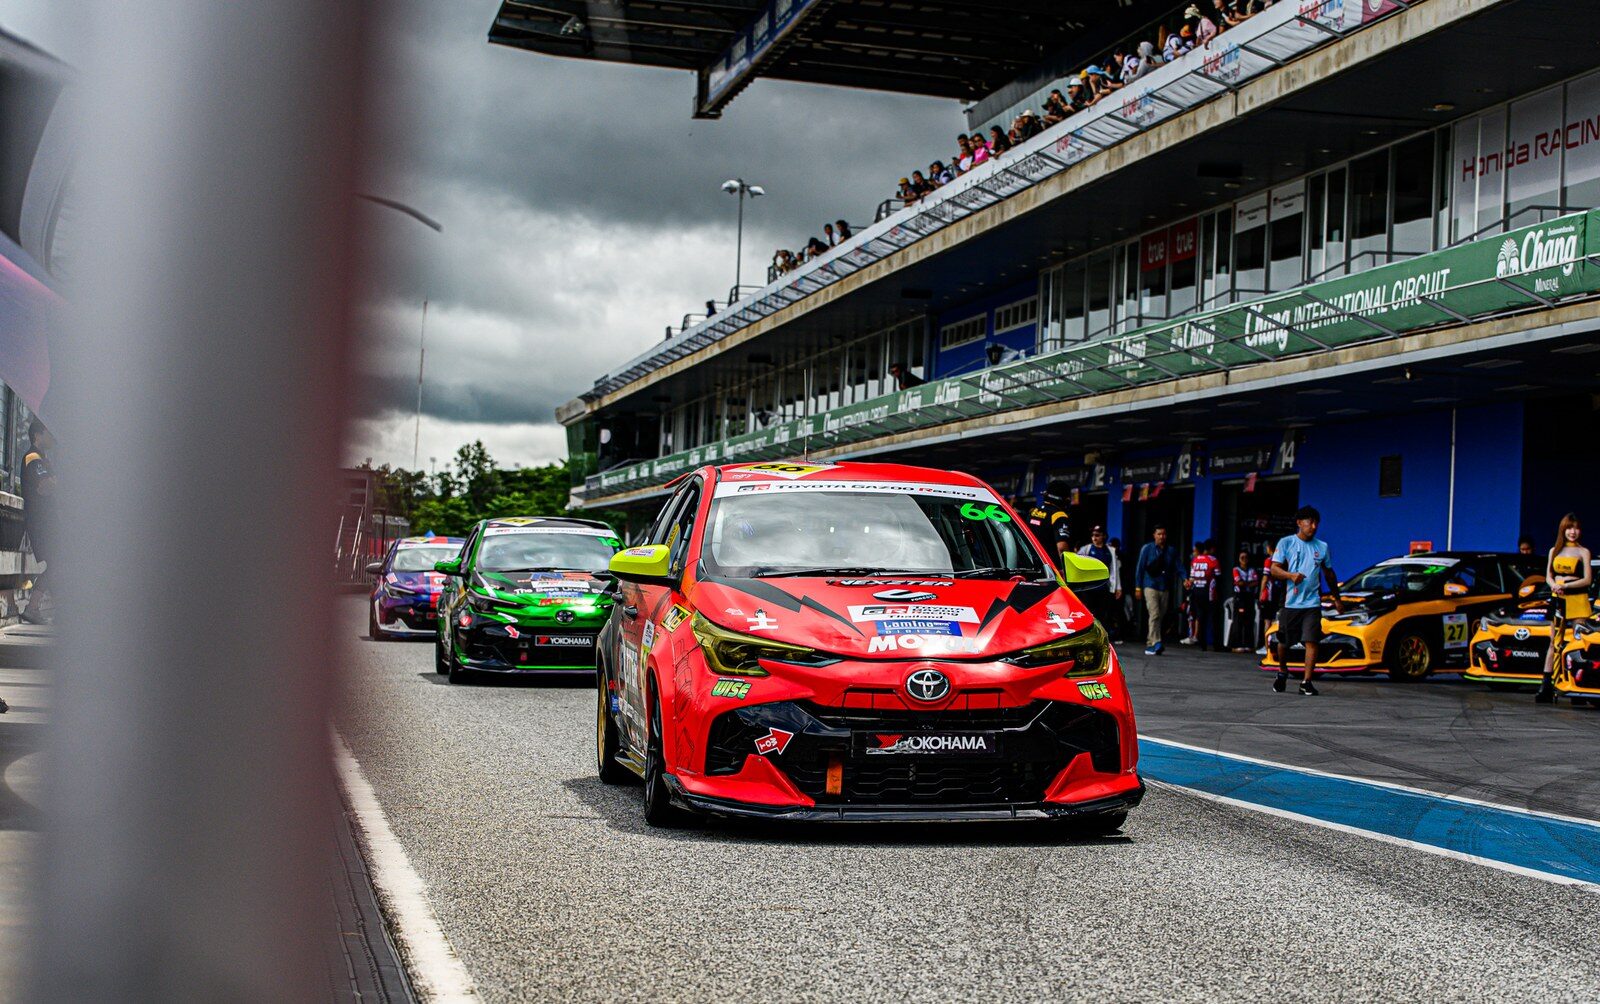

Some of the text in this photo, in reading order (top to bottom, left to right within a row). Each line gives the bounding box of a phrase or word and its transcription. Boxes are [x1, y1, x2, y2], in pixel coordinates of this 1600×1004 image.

[1462, 140, 1530, 182] Honda
[1147, 240, 1165, 264] true
[1176, 230, 1194, 255] true
[1520, 229, 1578, 277] Chang
[1244, 267, 1451, 352] Chang INTERNATIONAL CIRCUIT
[1279, 440, 1296, 470] 14
[918, 486, 977, 498] Racing
[959, 502, 1012, 523] 66
[883, 620, 934, 628] Lamina
[1447, 623, 1465, 641] 27
[549, 637, 592, 646] YOKOHAMA
[1511, 650, 1540, 659] YOKOHAMA
[711, 679, 753, 700] WISE
[1077, 682, 1112, 700] WISE
